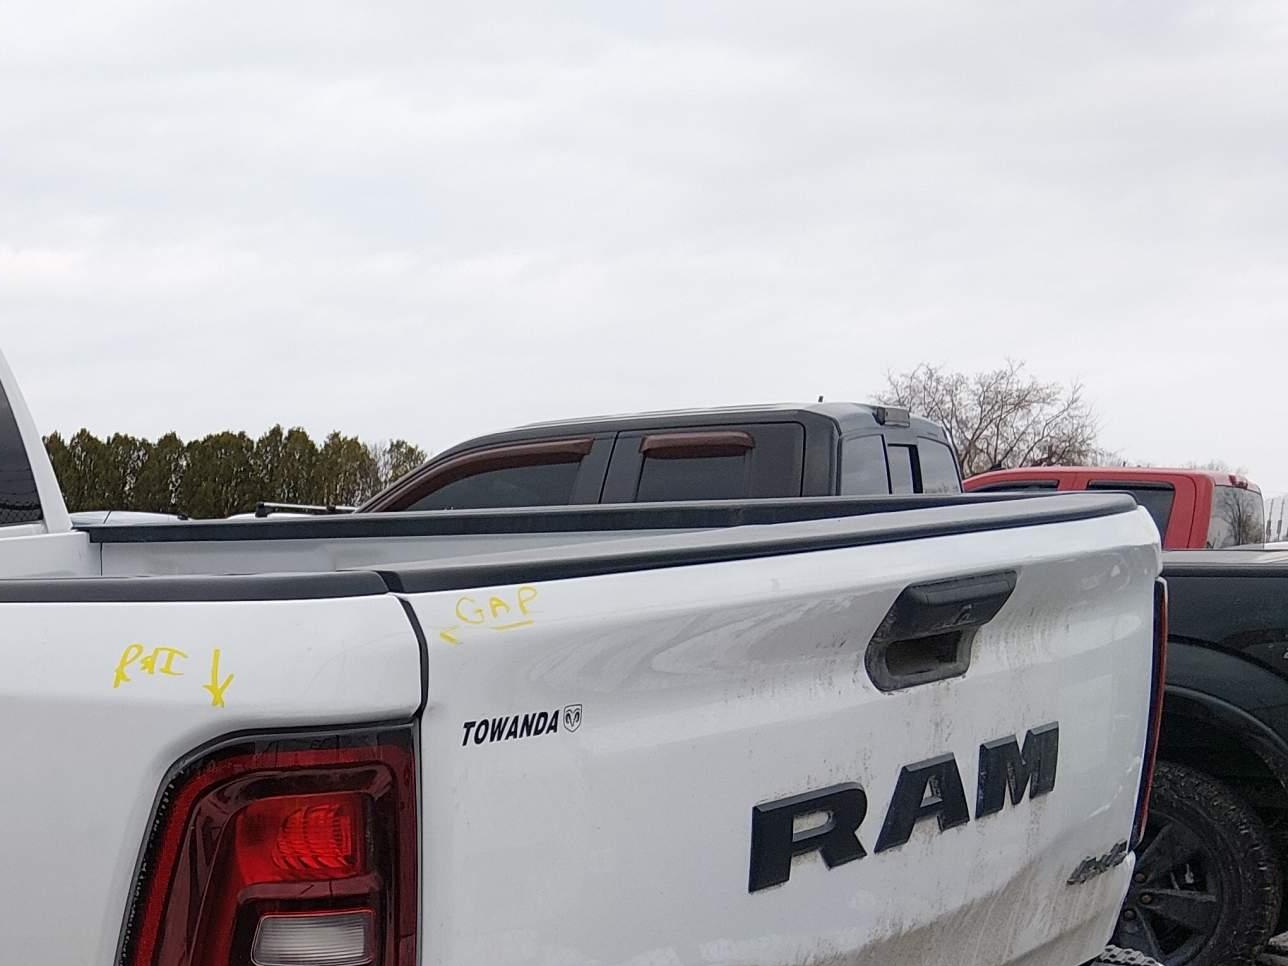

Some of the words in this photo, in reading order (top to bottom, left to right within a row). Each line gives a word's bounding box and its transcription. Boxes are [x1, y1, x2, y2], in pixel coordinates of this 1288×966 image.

[455, 586, 537, 625] GAP
[462, 710, 560, 746] TOWANDA
[748, 721, 1059, 894] RAM
